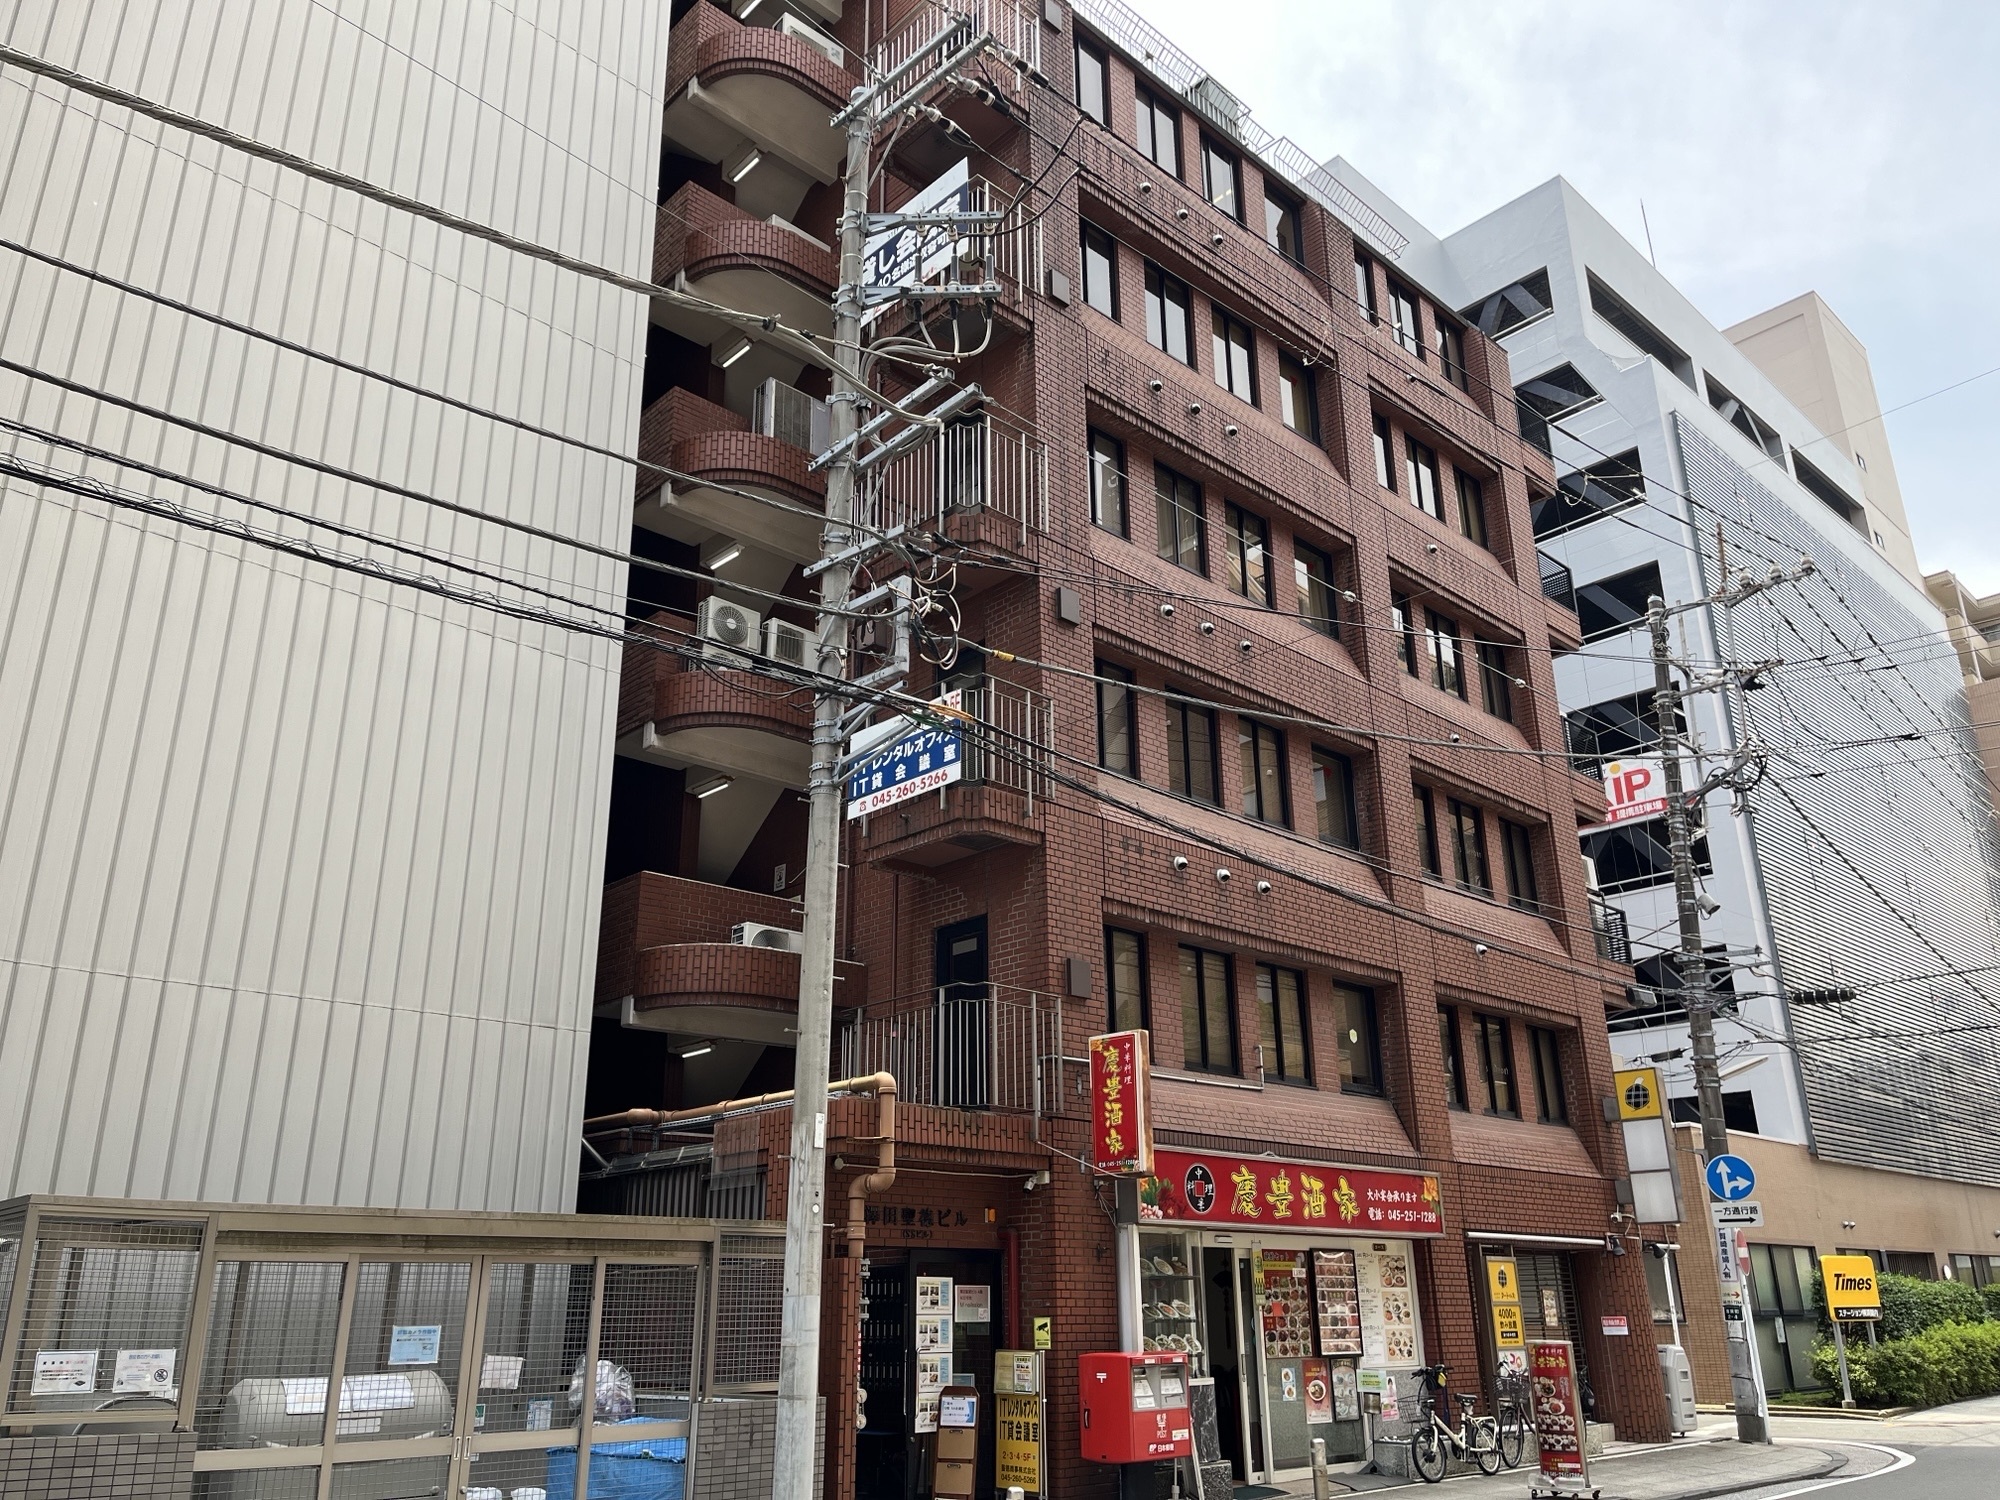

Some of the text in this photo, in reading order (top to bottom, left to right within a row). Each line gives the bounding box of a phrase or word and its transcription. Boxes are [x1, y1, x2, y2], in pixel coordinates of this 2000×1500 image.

[871, 769, 948, 808] 045-260-5266
[1123, 1042, 1133, 1084] 中華料理
[1367, 1188, 1418, 1203] 大小宴会承ります
[1387, 1209, 1437, 1223] 045-251-1288
[1714, 1205, 1759, 1216] 一方通行路
[1834, 1273, 1872, 1291] Times
